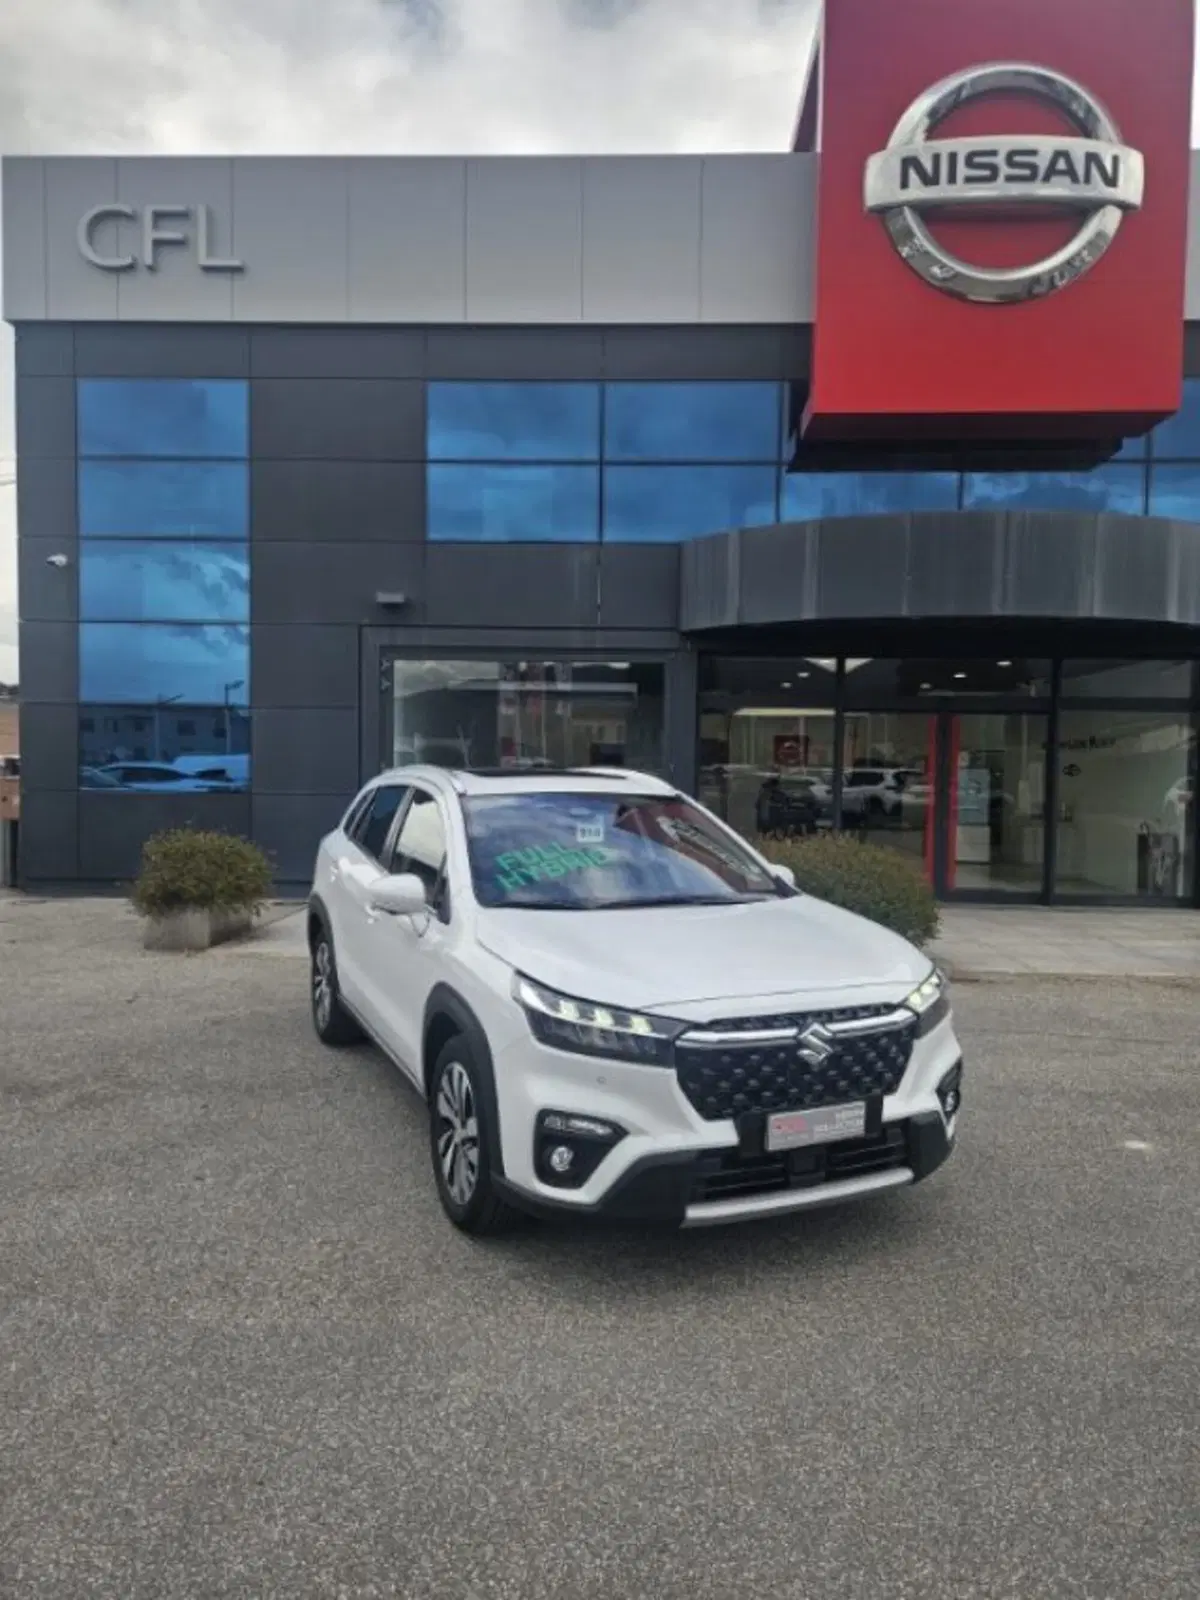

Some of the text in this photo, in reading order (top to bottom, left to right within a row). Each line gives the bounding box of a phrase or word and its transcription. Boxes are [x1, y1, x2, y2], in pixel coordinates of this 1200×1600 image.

[900, 149, 1120, 190] NISSAN
[78, 204, 244, 272] CFL
[496, 842, 573, 872] FULL
